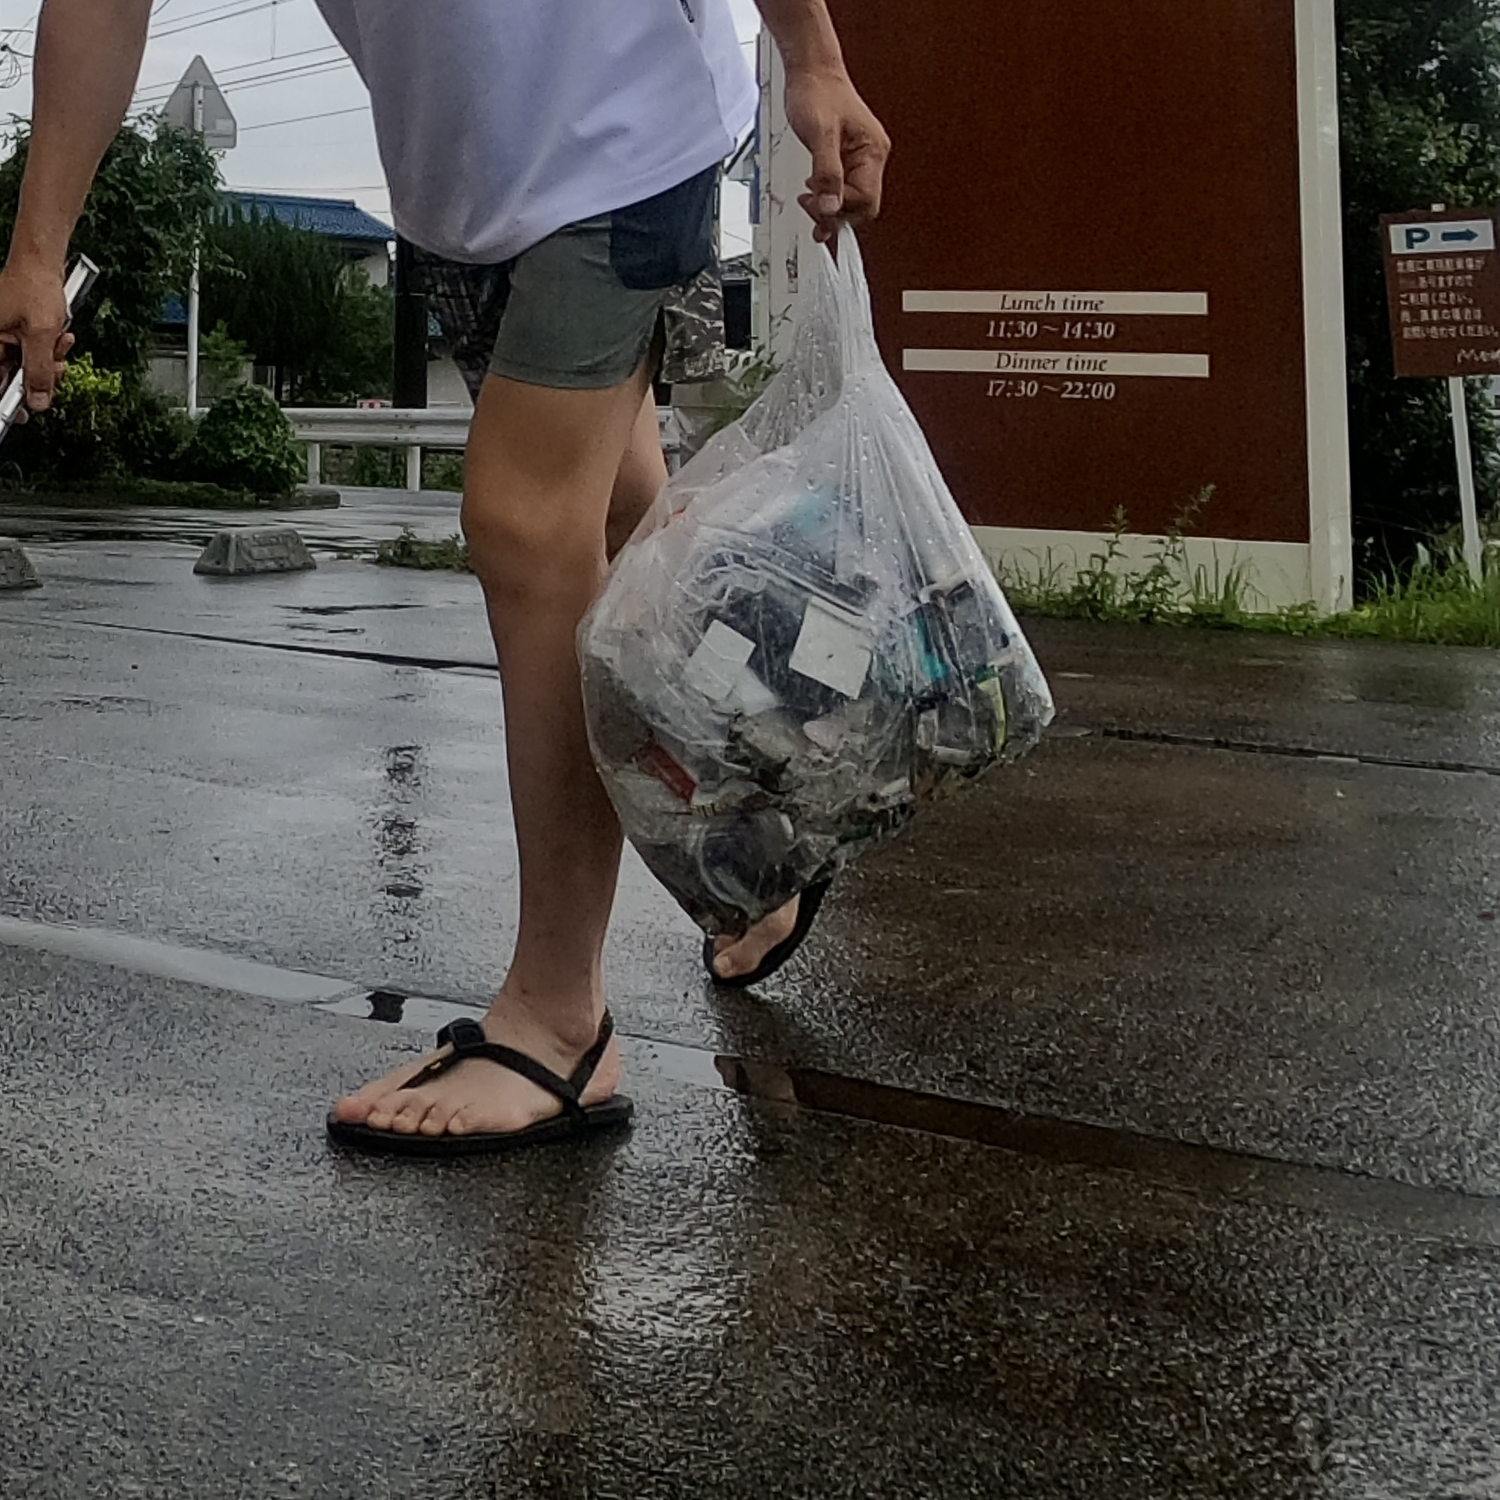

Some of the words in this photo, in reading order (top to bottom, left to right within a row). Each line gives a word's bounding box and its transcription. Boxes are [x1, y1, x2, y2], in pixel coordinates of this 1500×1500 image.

[1405, 227, 1430, 250] P
[1001, 294, 1057, 312] Lunch
[1062, 294, 1105, 312] time
[996, 353, 1061, 371] Dinner
[1066, 354, 1109, 372] time
